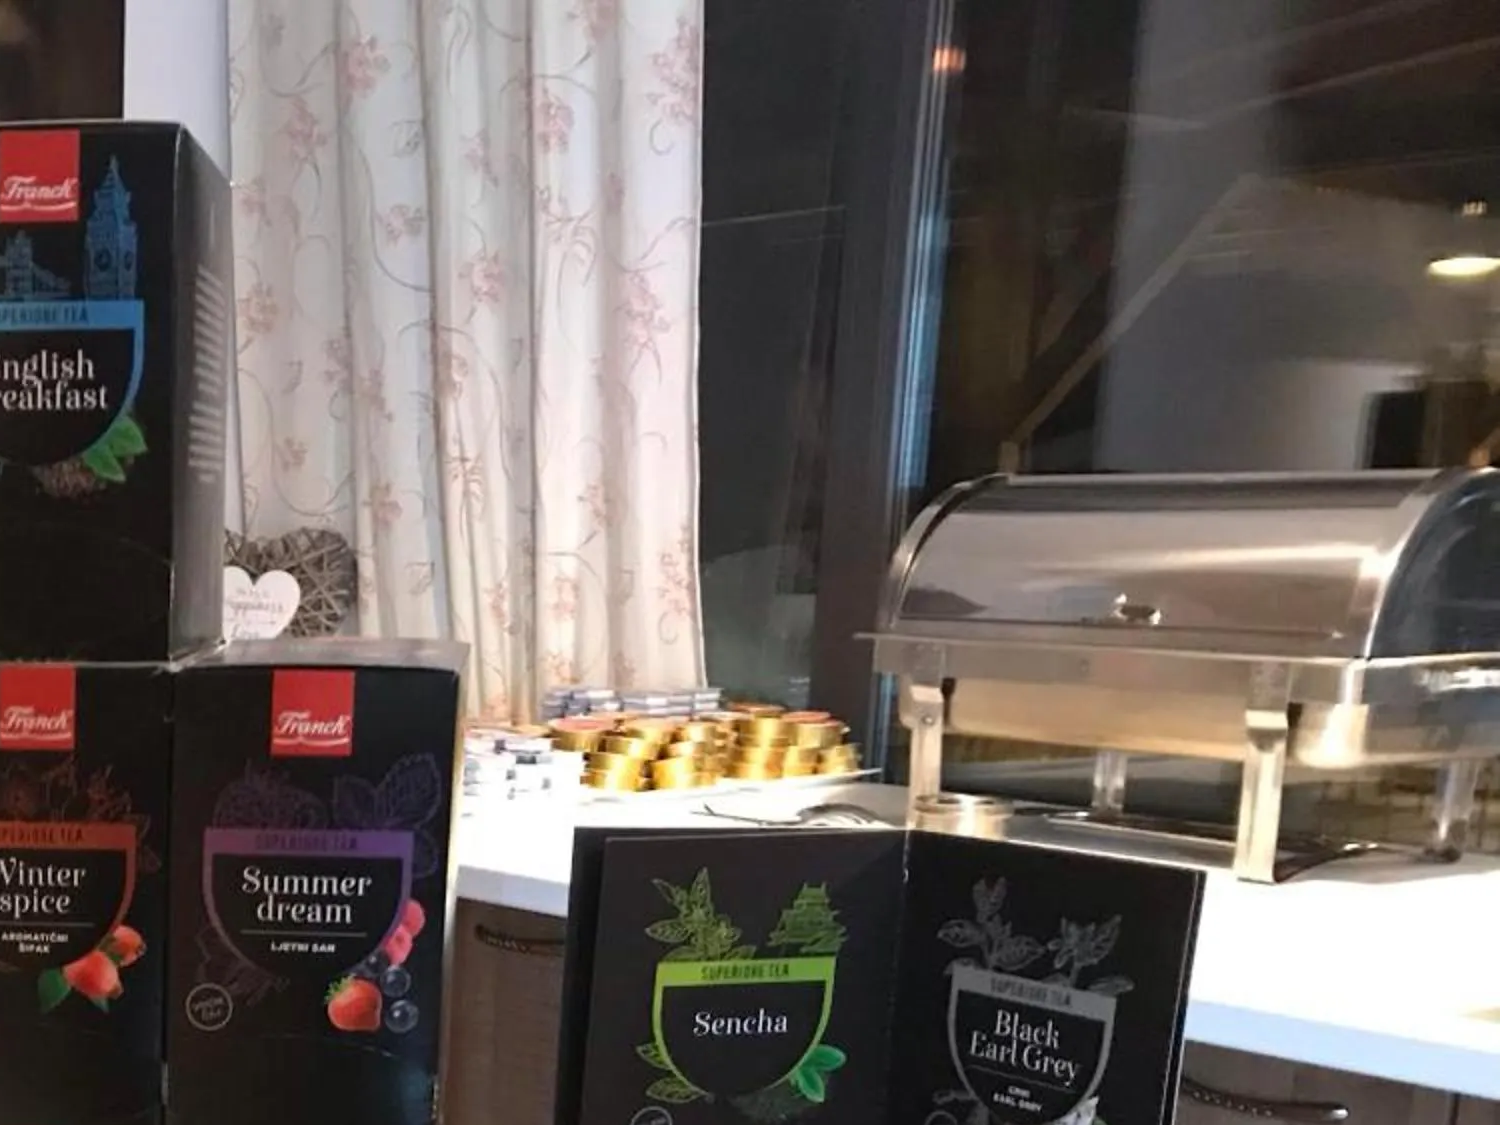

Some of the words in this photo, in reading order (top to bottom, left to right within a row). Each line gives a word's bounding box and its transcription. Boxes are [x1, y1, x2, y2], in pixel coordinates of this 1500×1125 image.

[1, 175, 78, 200] Franck
[63, 305, 90, 322] TEA
[1, 705, 74, 730] Franck
[276, 710, 351, 735] Franck
[57, 827, 84, 842] TEA
[241, 865, 373, 897] Summer
[0, 888, 71, 919] spice
[256, 894, 352, 924] dream
[311, 942, 336, 954] SAN
[764, 963, 790, 978] TEA
[692, 1008, 788, 1037] Sencha
[994, 1009, 1061, 1050] Black
[969, 1030, 1018, 1067] Earl
[1022, 1043, 1080, 1087] Grey
